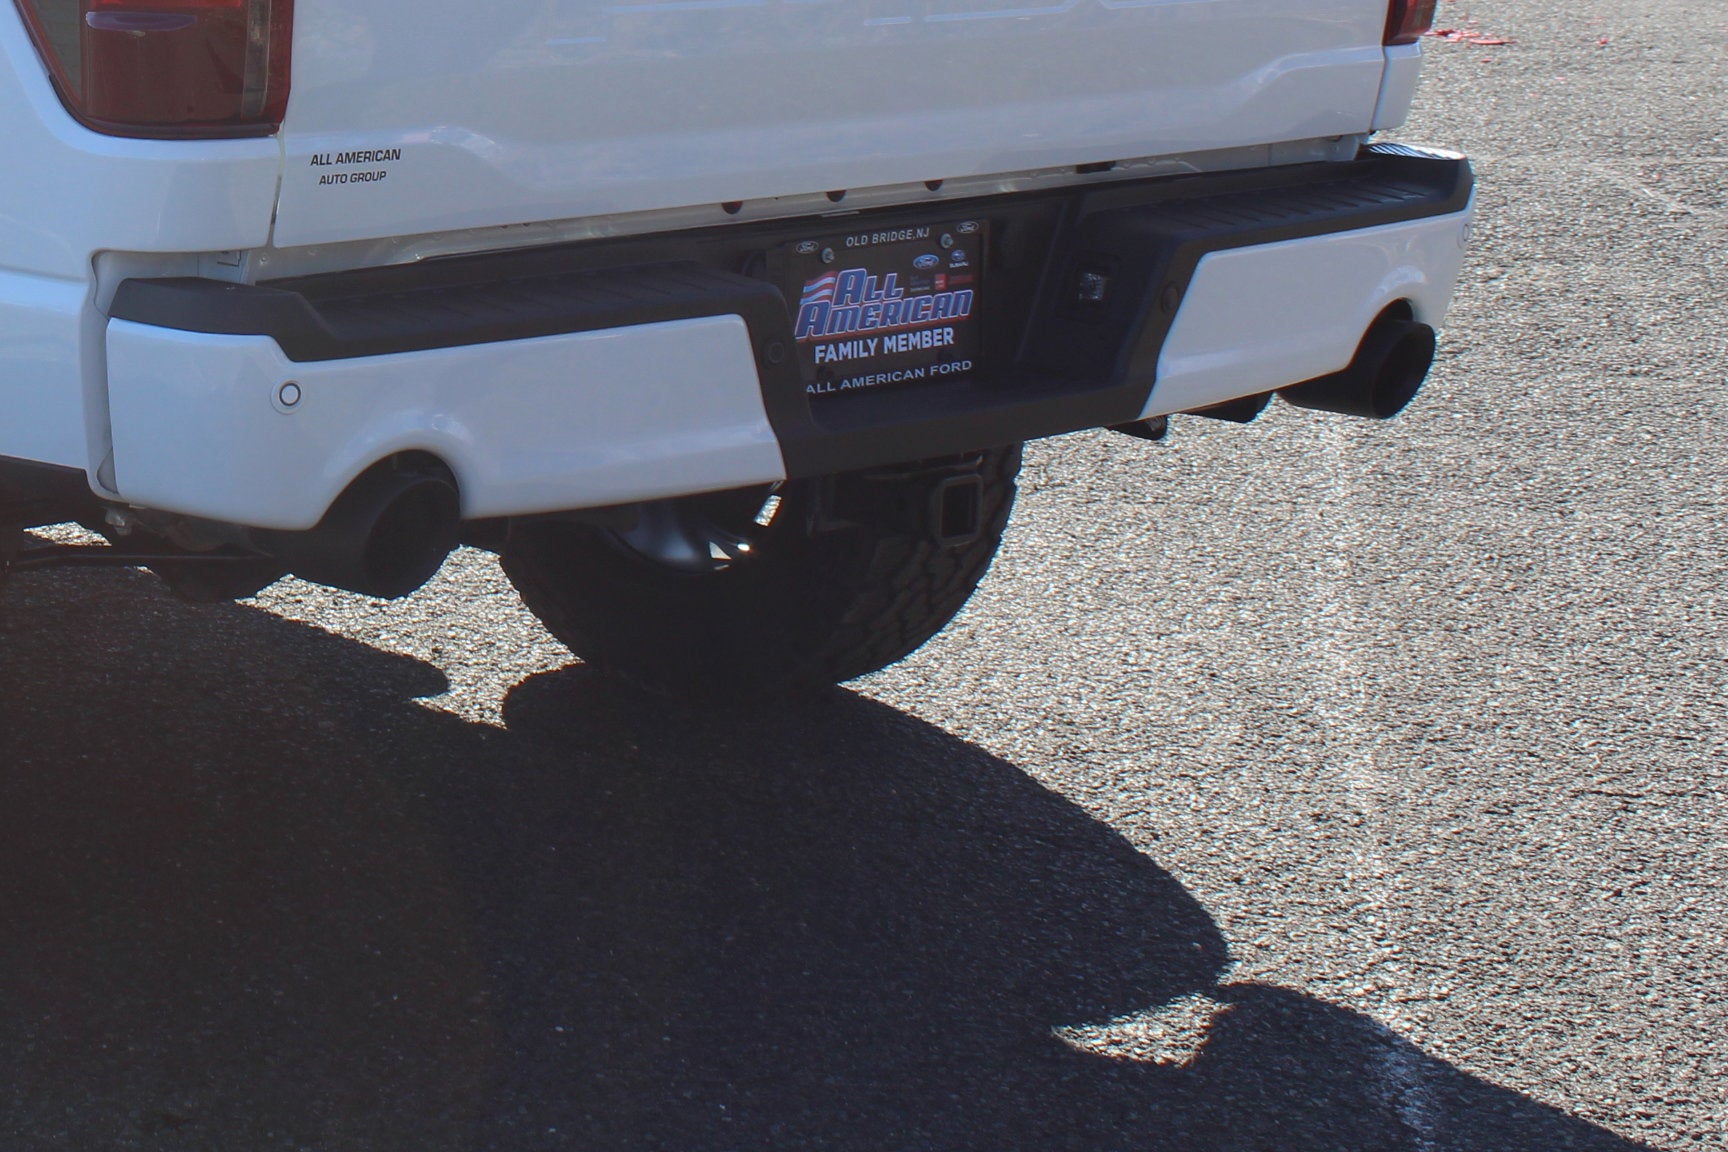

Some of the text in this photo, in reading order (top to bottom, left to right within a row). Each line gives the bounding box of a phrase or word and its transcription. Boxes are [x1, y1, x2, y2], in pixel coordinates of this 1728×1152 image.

[310, 148, 402, 166] ALL AMERICAN
[318, 170, 387, 185] AUTO GROUP
[845, 235, 868, 247] OLD
[831, 267, 904, 308] ALL
[794, 289, 974, 340] AMERICAN
[814, 327, 954, 364] FAMILY MEMBER
[806, 360, 972, 394] ALL AMERICAN FORD
